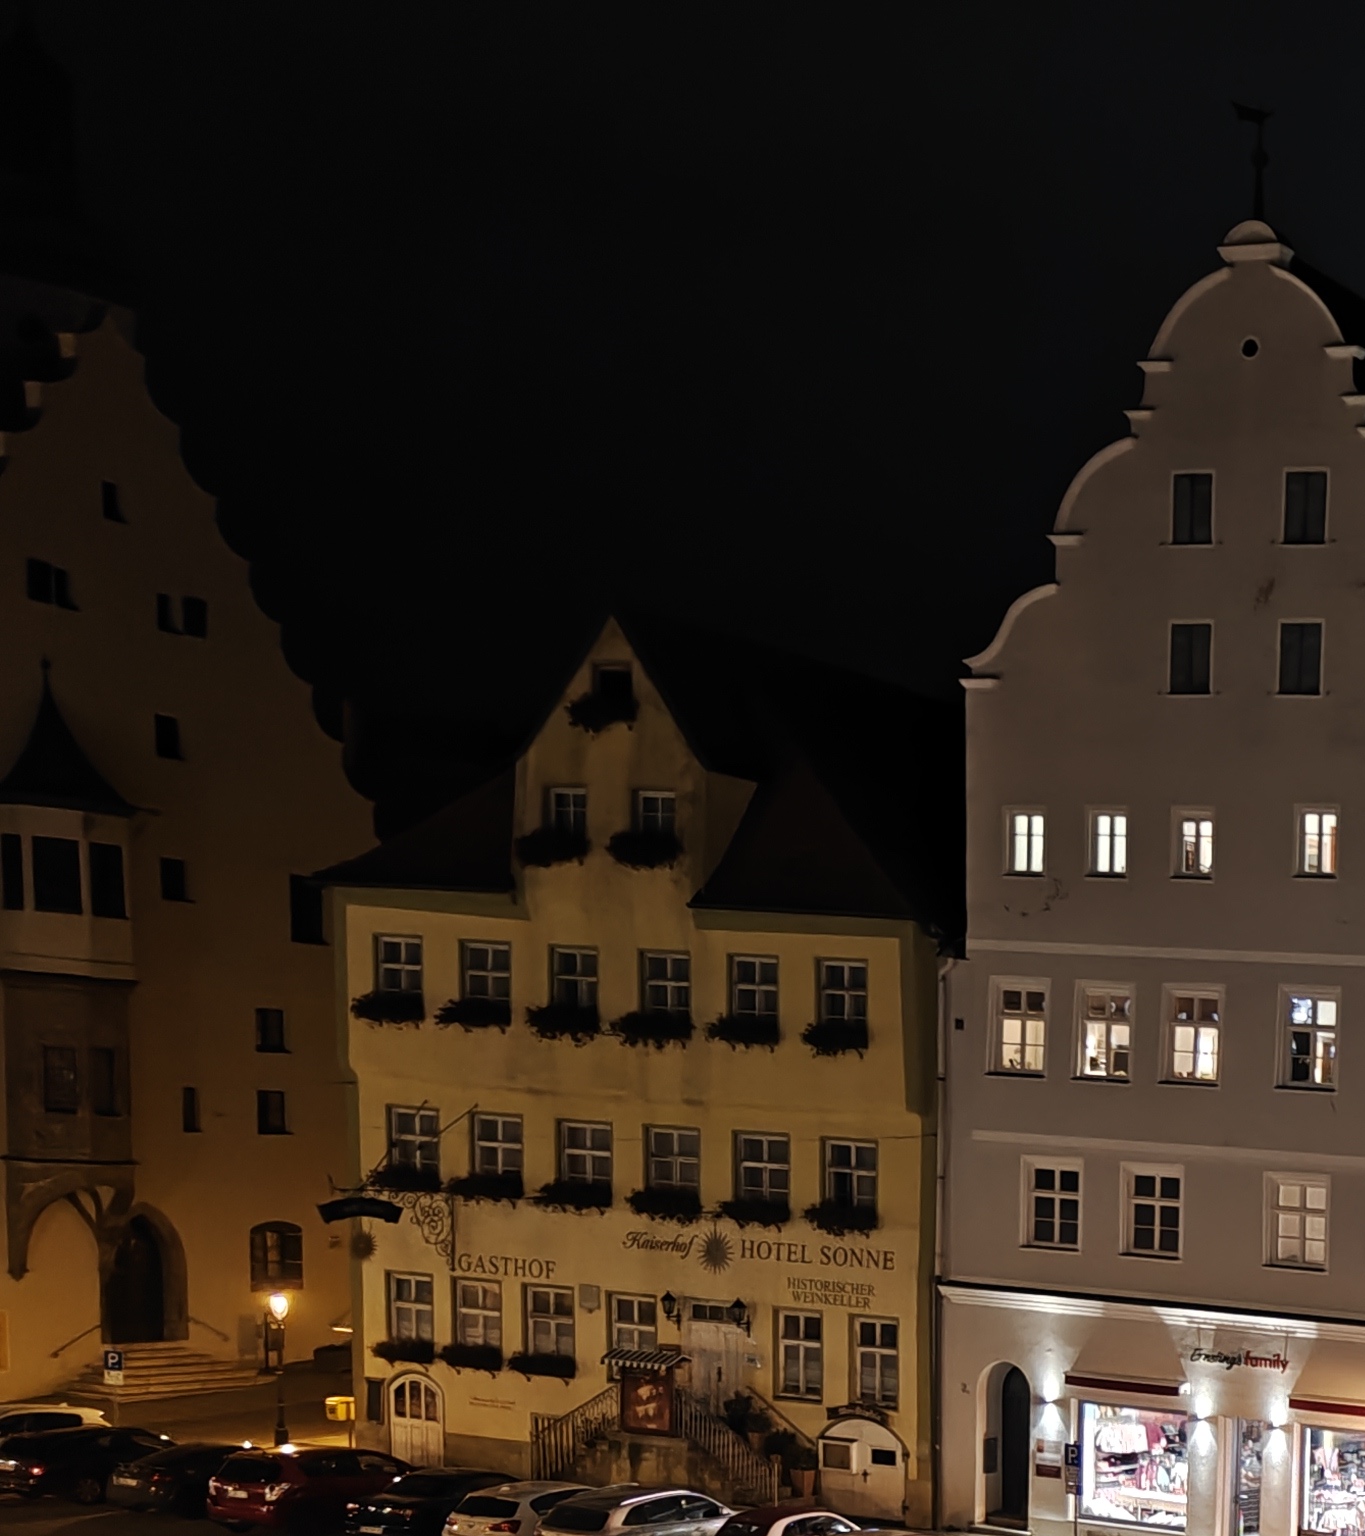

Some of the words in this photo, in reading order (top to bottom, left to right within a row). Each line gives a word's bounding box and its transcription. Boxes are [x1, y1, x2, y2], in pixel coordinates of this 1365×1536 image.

[622, 1231, 698, 1259] Kaiserhof
[741, 1239, 812, 1264] HOTEL
[819, 1245, 895, 1271] SONNE
[457, 1253, 556, 1279] GASTHOF
[787, 1276, 876, 1297] HISTORISCHER
[791, 1291, 872, 1310] WEINKELLER
[1244, 1350, 1289, 1374] family
